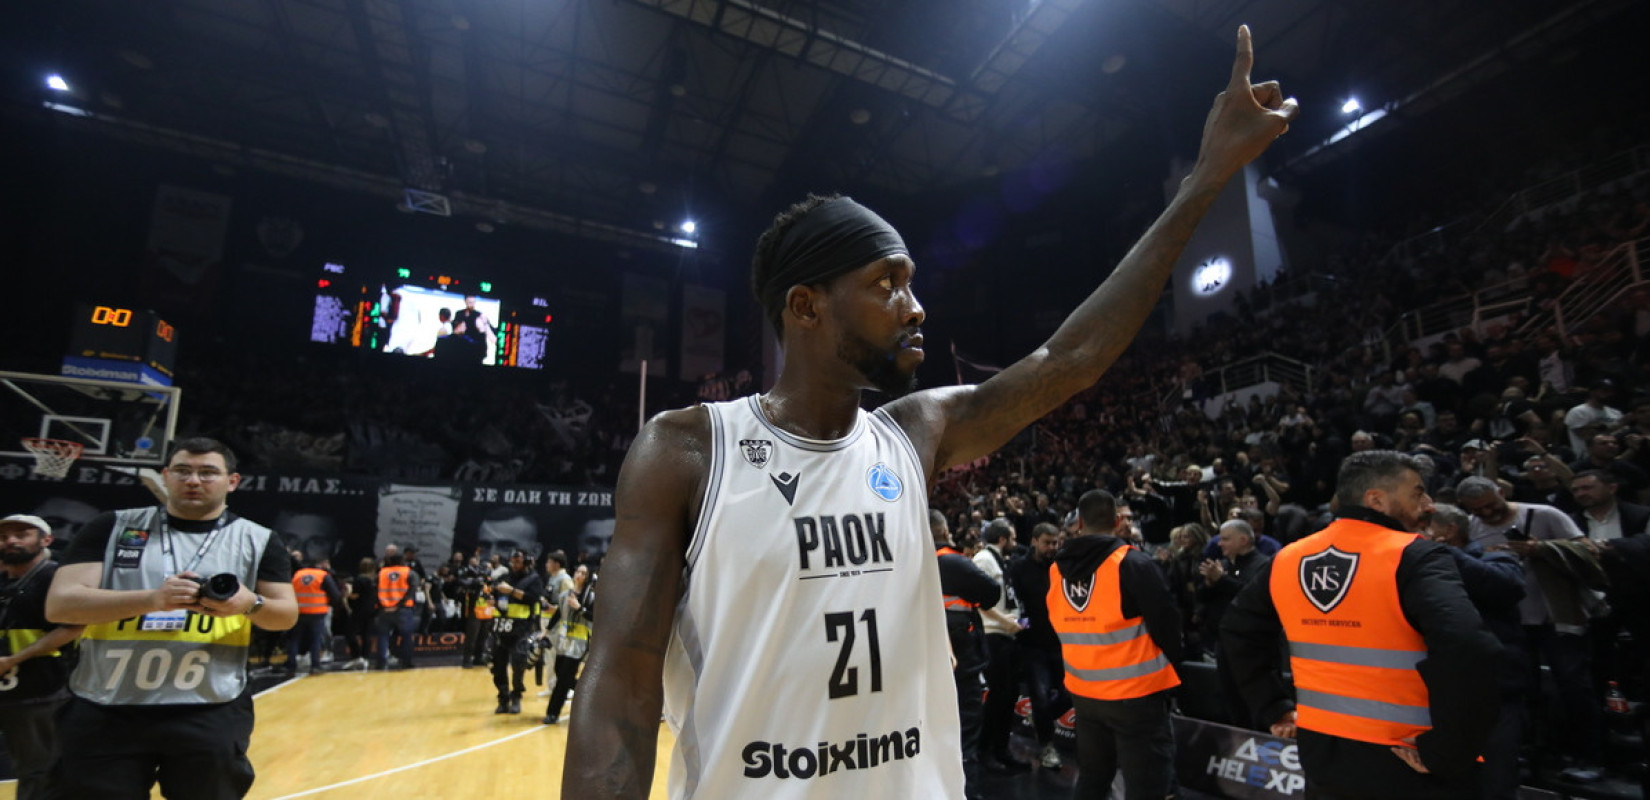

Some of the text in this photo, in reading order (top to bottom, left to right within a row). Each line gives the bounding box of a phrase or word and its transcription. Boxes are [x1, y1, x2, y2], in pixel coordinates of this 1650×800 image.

[473, 487, 612, 506] ΣΕ ΟΛΗ ΤΗ ΖΩΗ
[793, 512, 893, 570] PAOK
[105, 648, 210, 691] 706
[824, 608, 882, 699] 21
[742, 726, 921, 779] Stoixima
[1206, 755, 1305, 796] HELEXP
